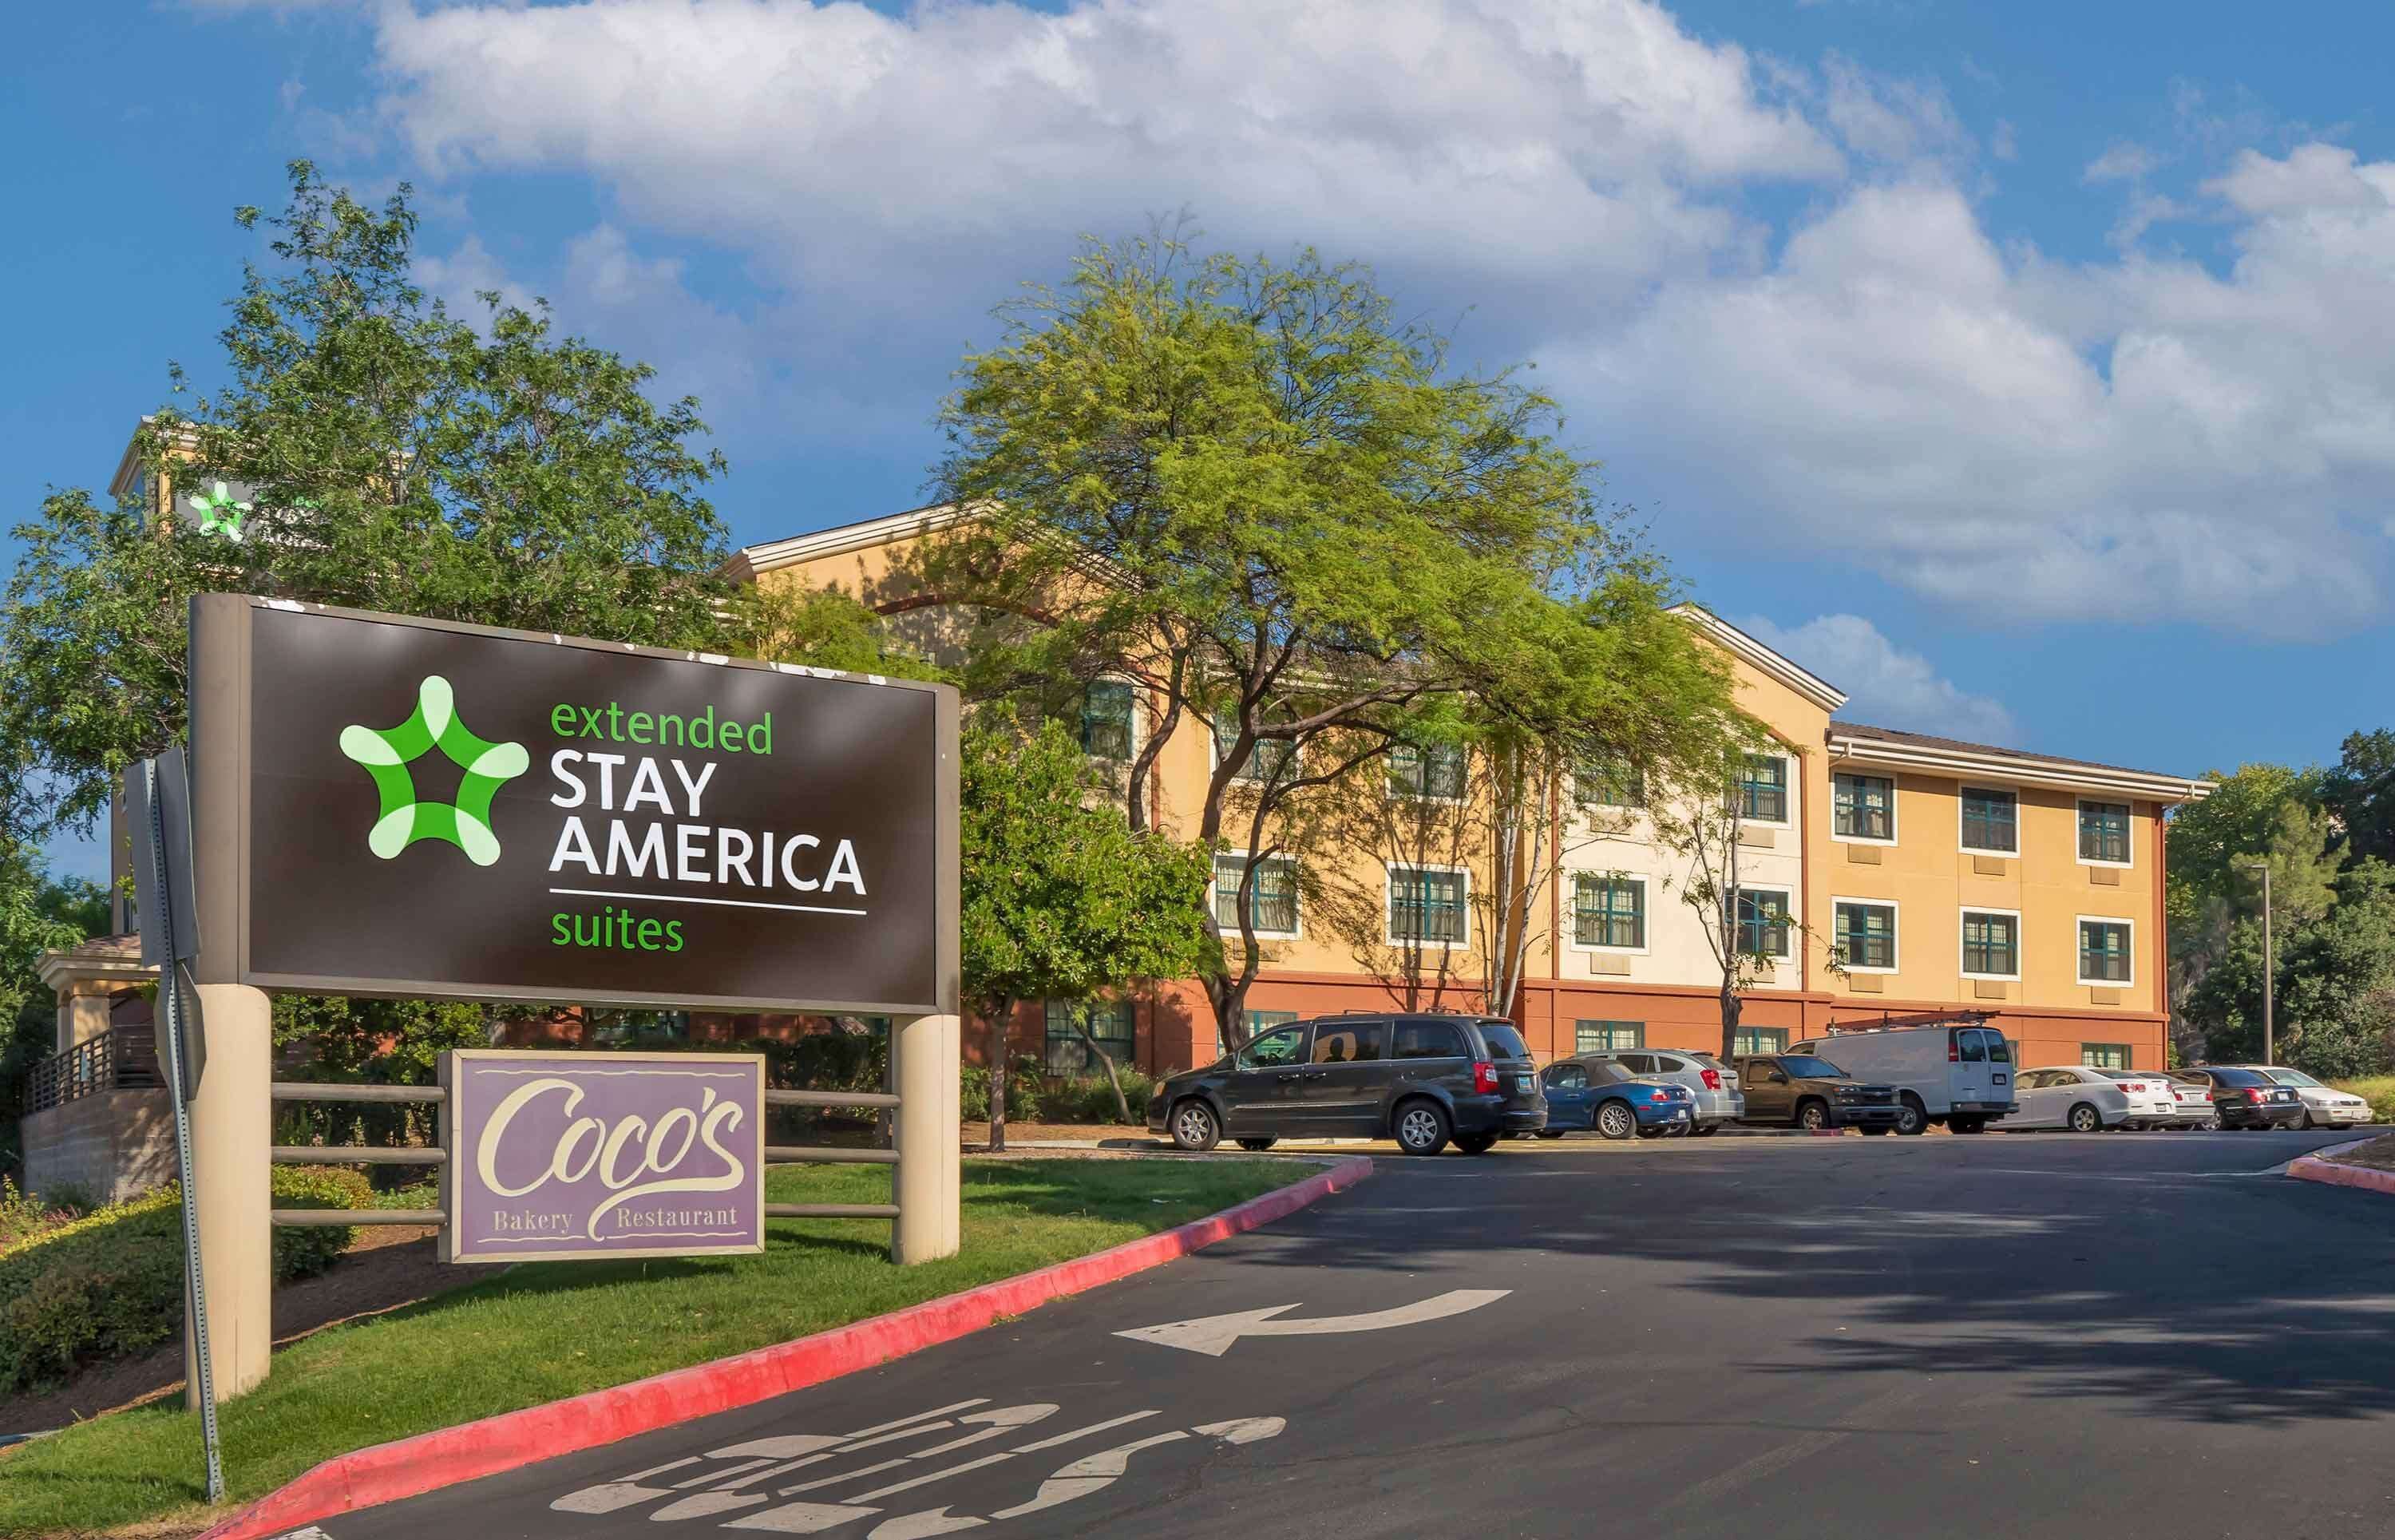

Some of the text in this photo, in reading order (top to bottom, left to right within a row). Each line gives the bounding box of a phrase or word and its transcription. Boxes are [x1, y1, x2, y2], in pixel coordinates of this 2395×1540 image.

[551, 702, 773, 754] extended
[549, 749, 718, 817] STAY
[548, 816, 868, 895] AMERICA
[551, 905, 685, 952] suites
[477, 1077, 746, 1242] Coco's
[493, 1206, 738, 1234] Bakery Restaurant
[549, 1398, 1287, 1540] STOP
